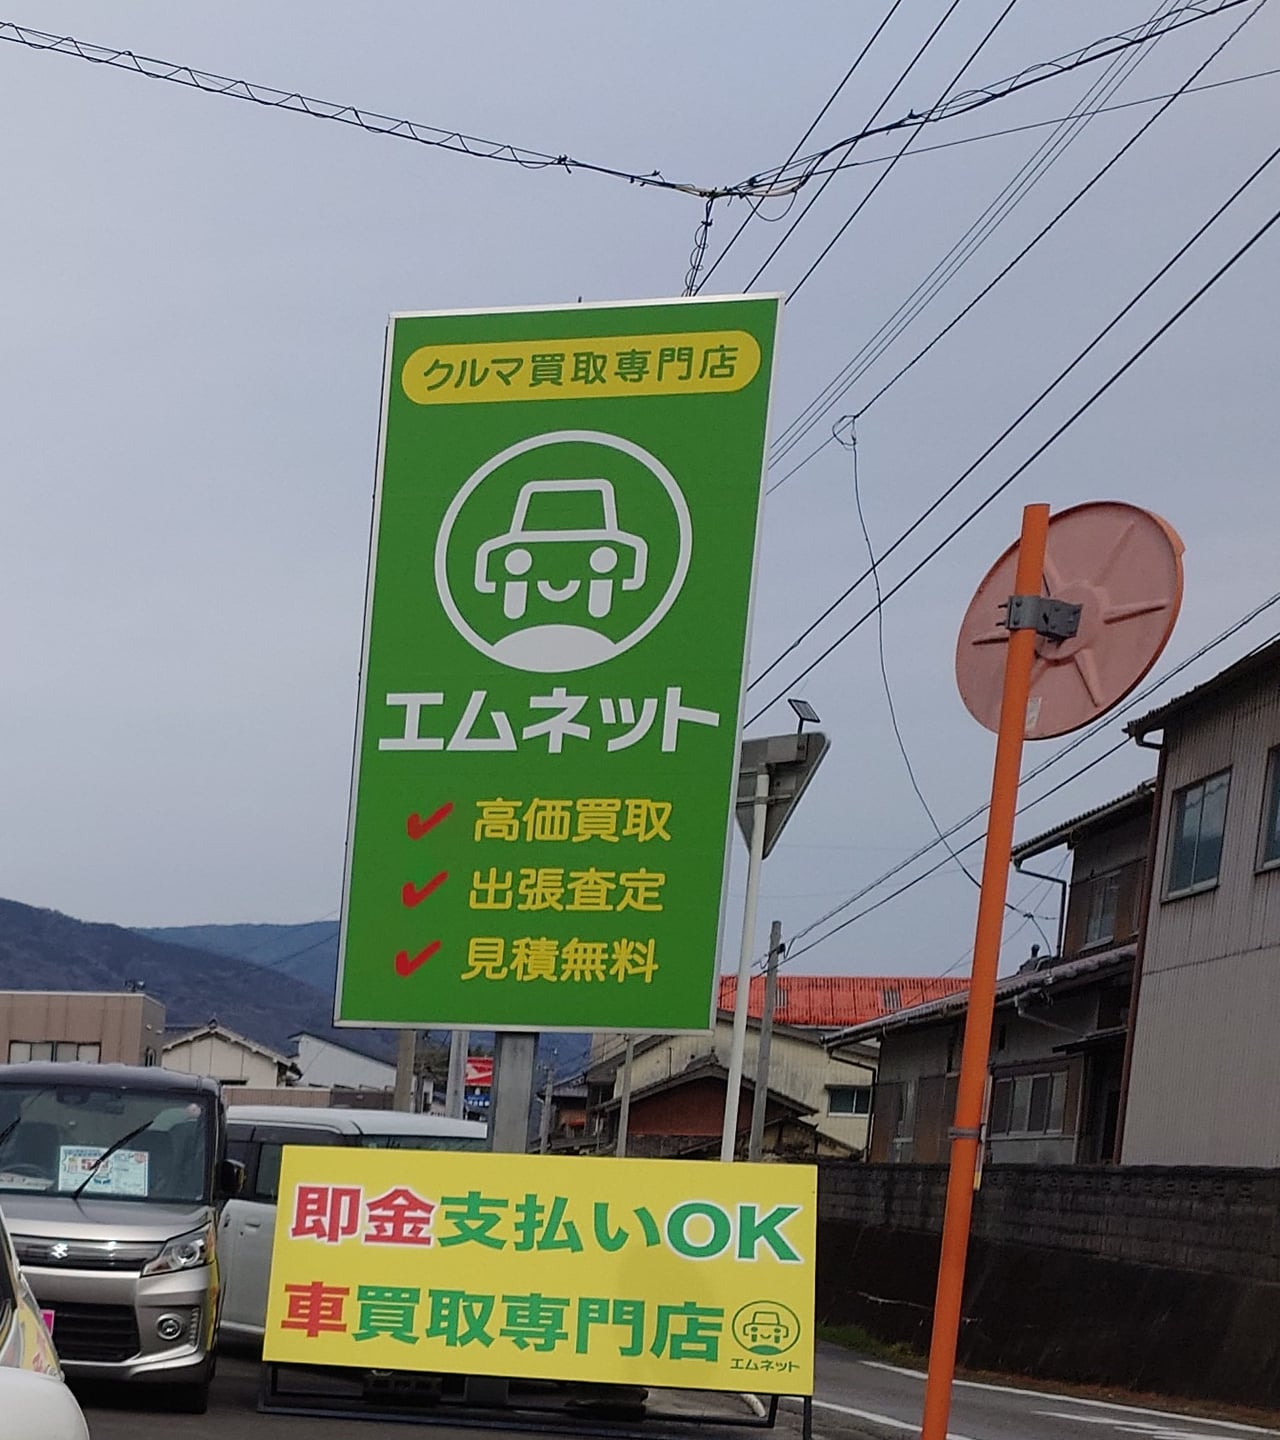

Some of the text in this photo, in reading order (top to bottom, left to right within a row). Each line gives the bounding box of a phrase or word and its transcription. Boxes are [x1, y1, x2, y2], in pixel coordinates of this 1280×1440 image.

[423, 344, 739, 391] クルマ買取専門店
[378, 687, 720, 753] エムネット
[474, 797, 672, 842] 高価買取
[468, 867, 666, 911] 出張査定
[460, 937, 659, 983] 見積無料
[289, 1184, 803, 1265] 即金支払いOK
[281, 1281, 725, 1363] 車買取専門店
[730, 1358, 800, 1373] エムネット
